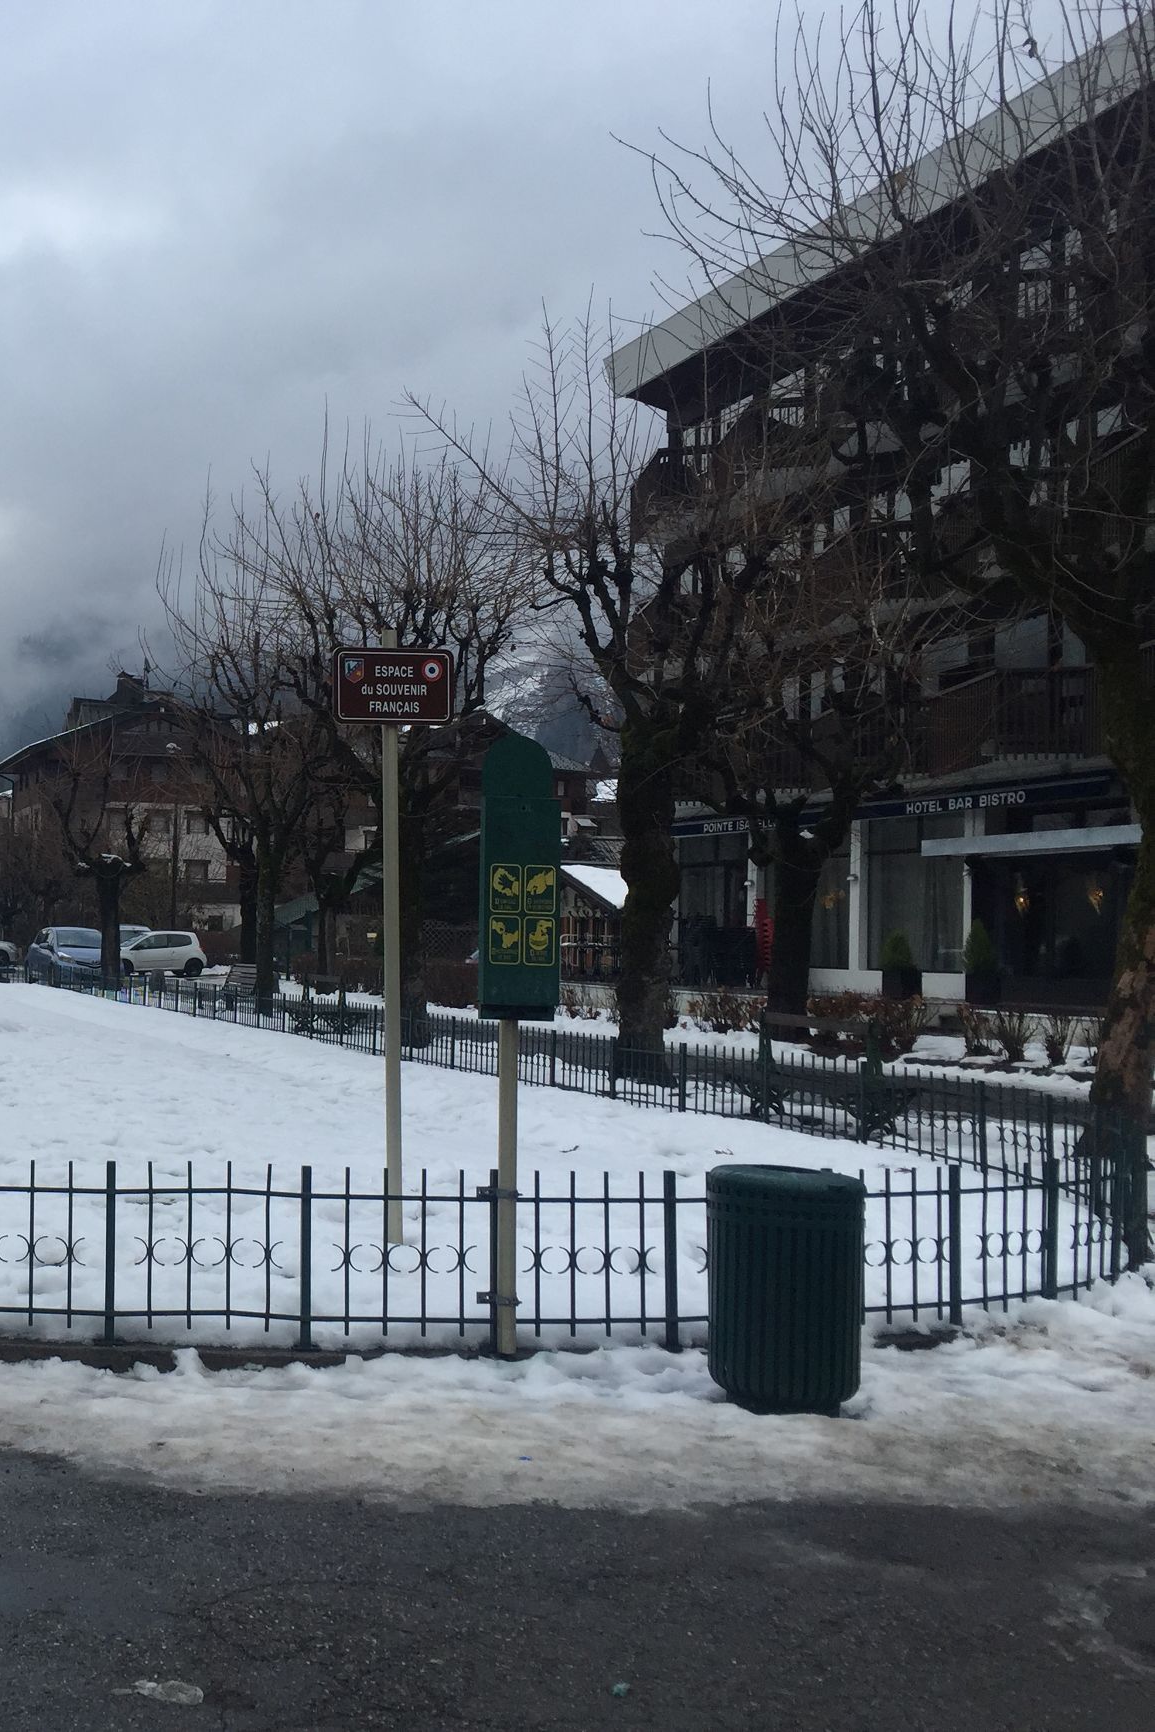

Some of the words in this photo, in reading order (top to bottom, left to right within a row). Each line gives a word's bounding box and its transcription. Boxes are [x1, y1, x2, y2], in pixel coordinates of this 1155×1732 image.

[375, 665, 414, 677] ESPACE
[361, 684, 374, 695] du
[376, 684, 427, 695] SOUVENIR
[369, 701, 420, 715] FRANÇAIS
[906, 800, 943, 814] HOTEL
[948, 797, 973, 810] BAR
[979, 791, 1026, 807] BISTRO
[703, 821, 734, 833] POINTE
